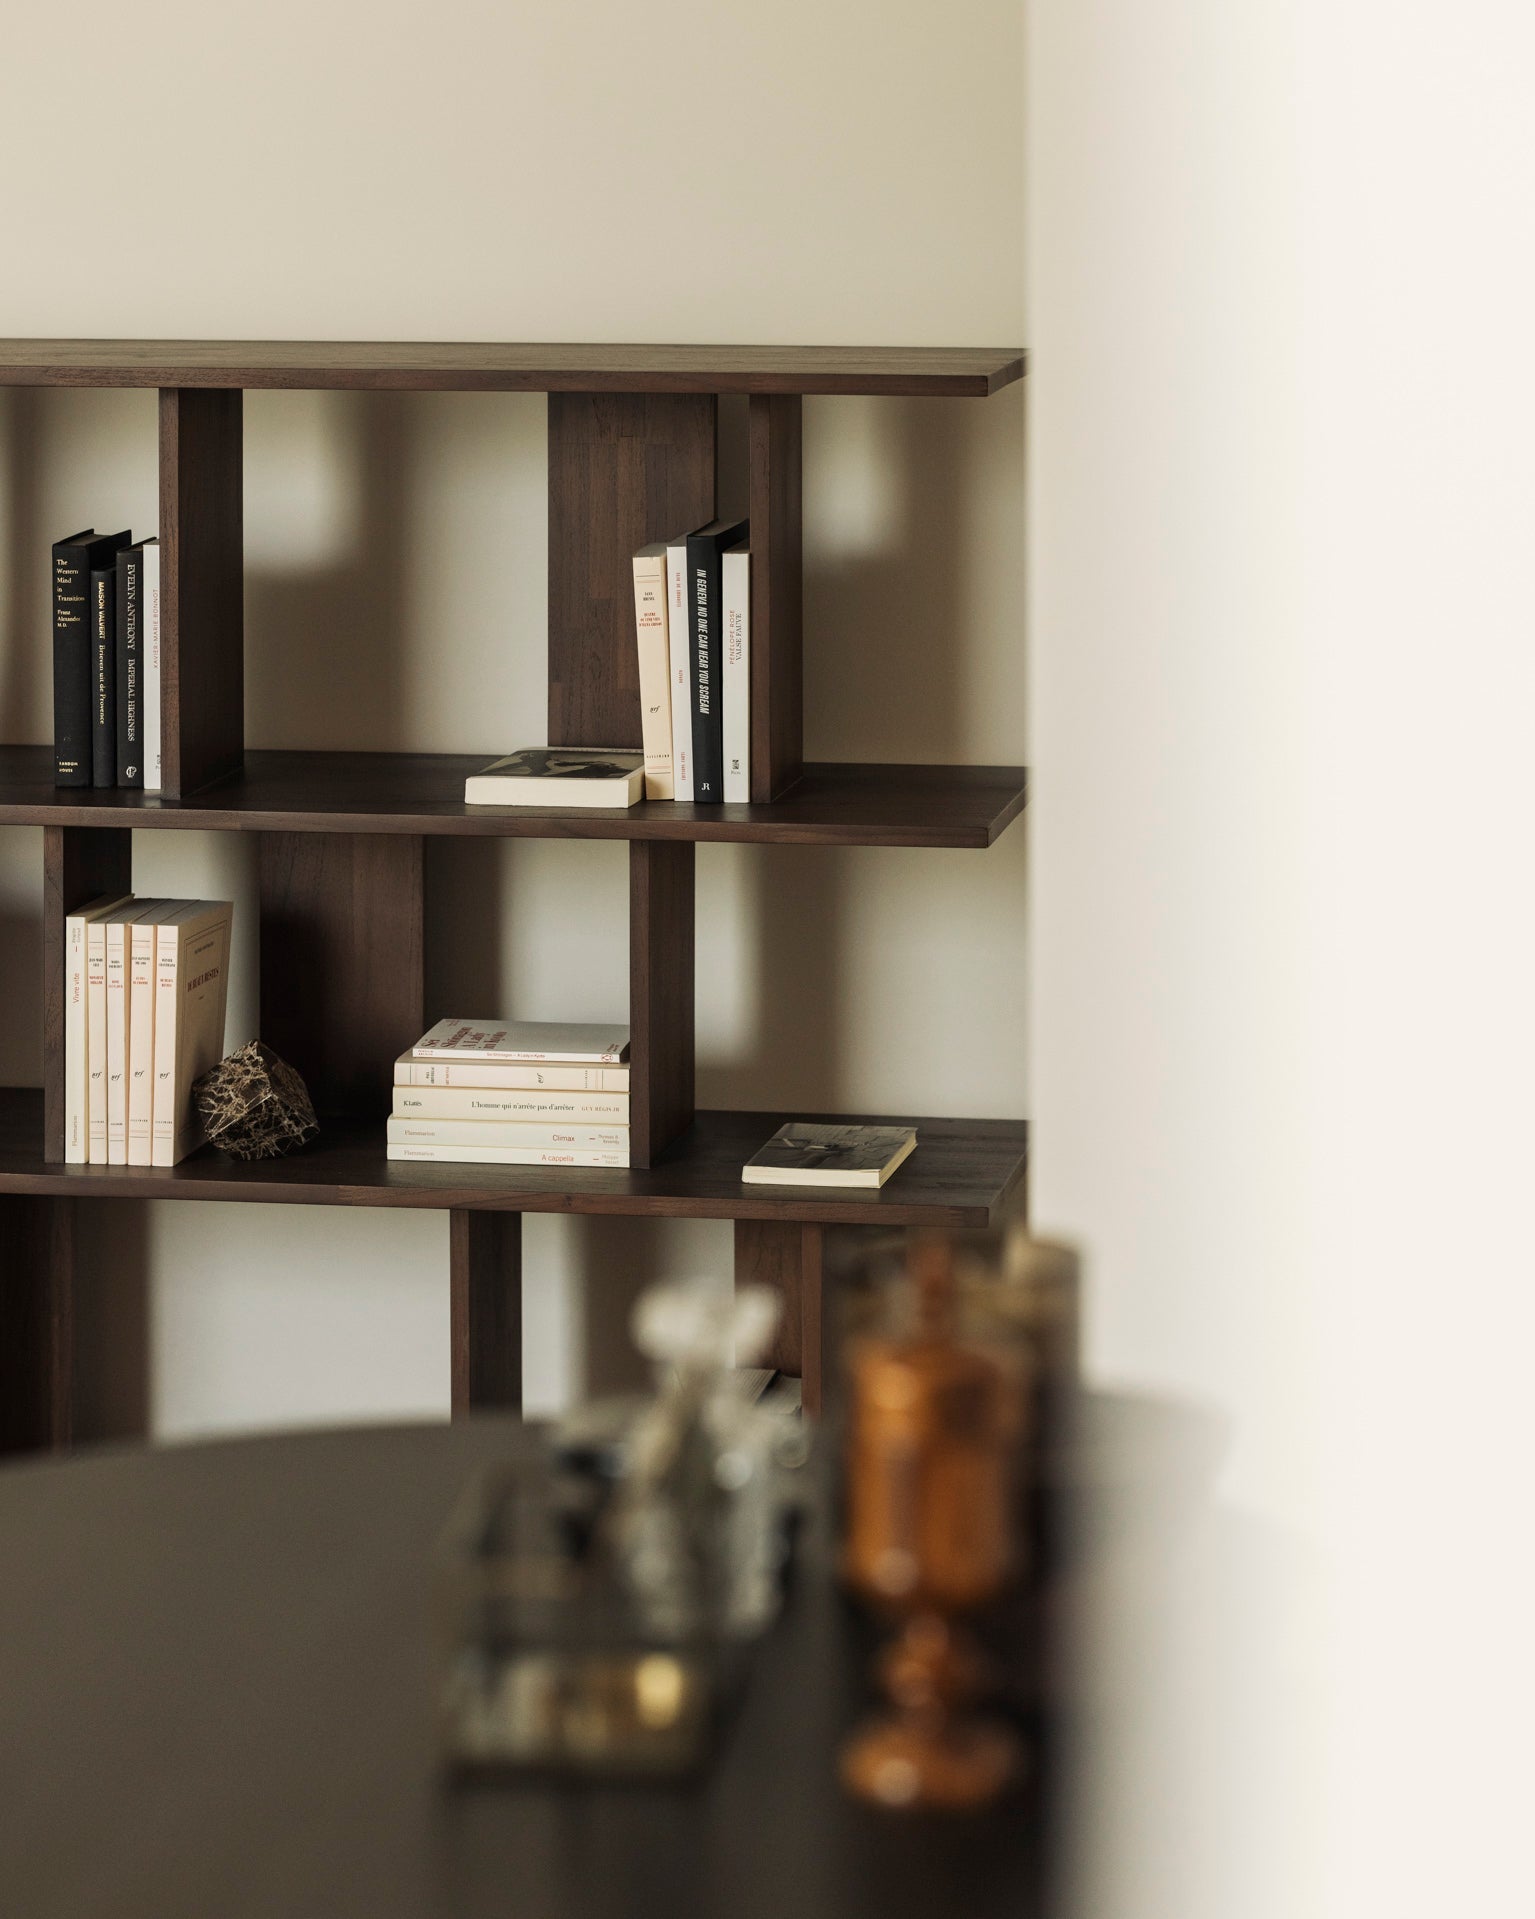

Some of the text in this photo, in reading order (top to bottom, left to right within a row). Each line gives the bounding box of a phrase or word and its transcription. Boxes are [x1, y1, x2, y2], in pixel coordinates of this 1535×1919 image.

[696, 568, 710, 714] IN GENEVA NO ONE CAN HEAR YOU SCREAM
[127, 564, 136, 742] EVELYN ANTHONY IMPERIAL HIGHNESS
[99, 683, 106, 692] de
[99, 693, 107, 725] Provence
[471, 1101, 501, 1109] L'homme
[501, 1102, 512, 1110] qui
[548, 1103, 575, 1111] d'arrêter
[404, 1129, 435, 1137] Flammarion
[552, 1134, 575, 1142] Climax
[403, 1149, 435, 1157] Flammarion
[548, 1154, 575, 1163] cappella
